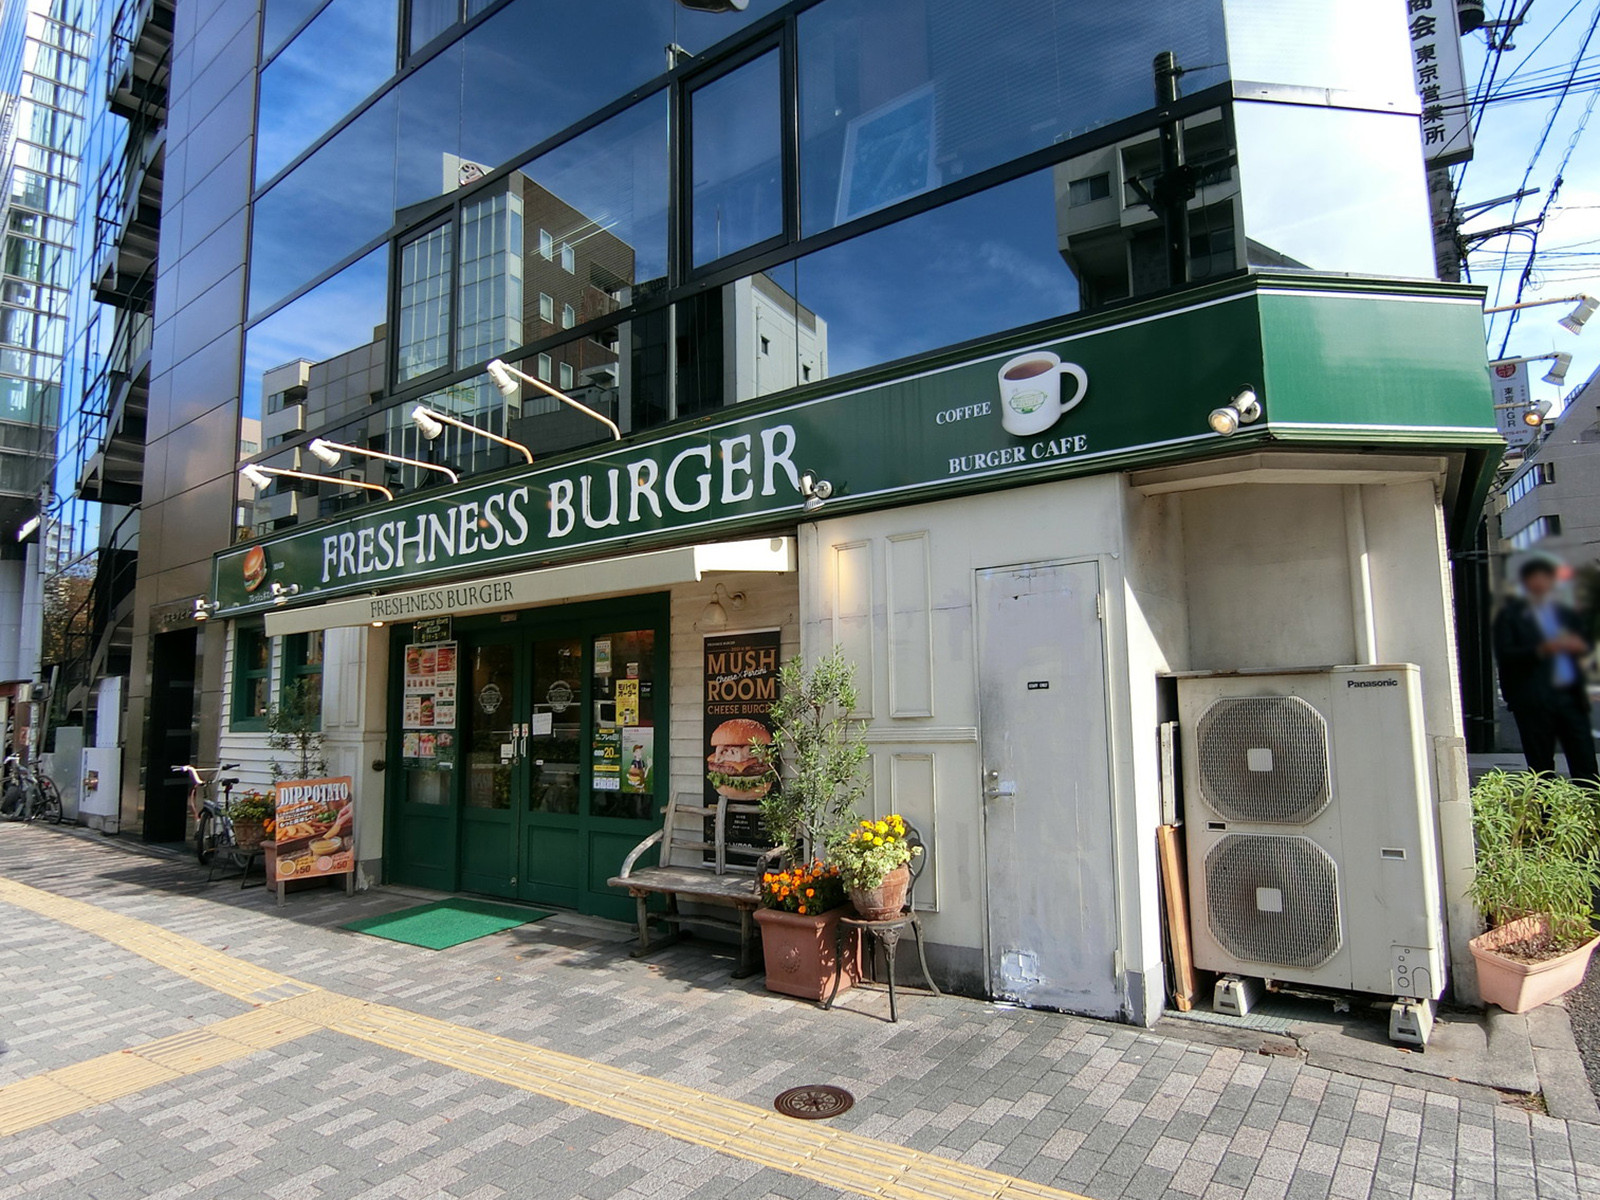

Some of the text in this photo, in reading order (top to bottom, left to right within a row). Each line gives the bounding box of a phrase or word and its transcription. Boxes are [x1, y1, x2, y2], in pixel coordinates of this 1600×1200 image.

[1415, 44, 1446, 146] 東京営業所
[935, 401, 992, 425] COFFEE
[1504, 387, 1516, 428] 東京GR
[948, 434, 1088, 474] BURGER CAFE
[321, 424, 801, 583] FRESHNESS BURGER
[370, 581, 514, 618] FRESHNESS BURGER
[707, 649, 776, 675] MUSH
[707, 677, 776, 701] ROOM
[1347, 678, 1398, 688] Panasonic
[707, 703, 772, 715] CHEESE BURGE
